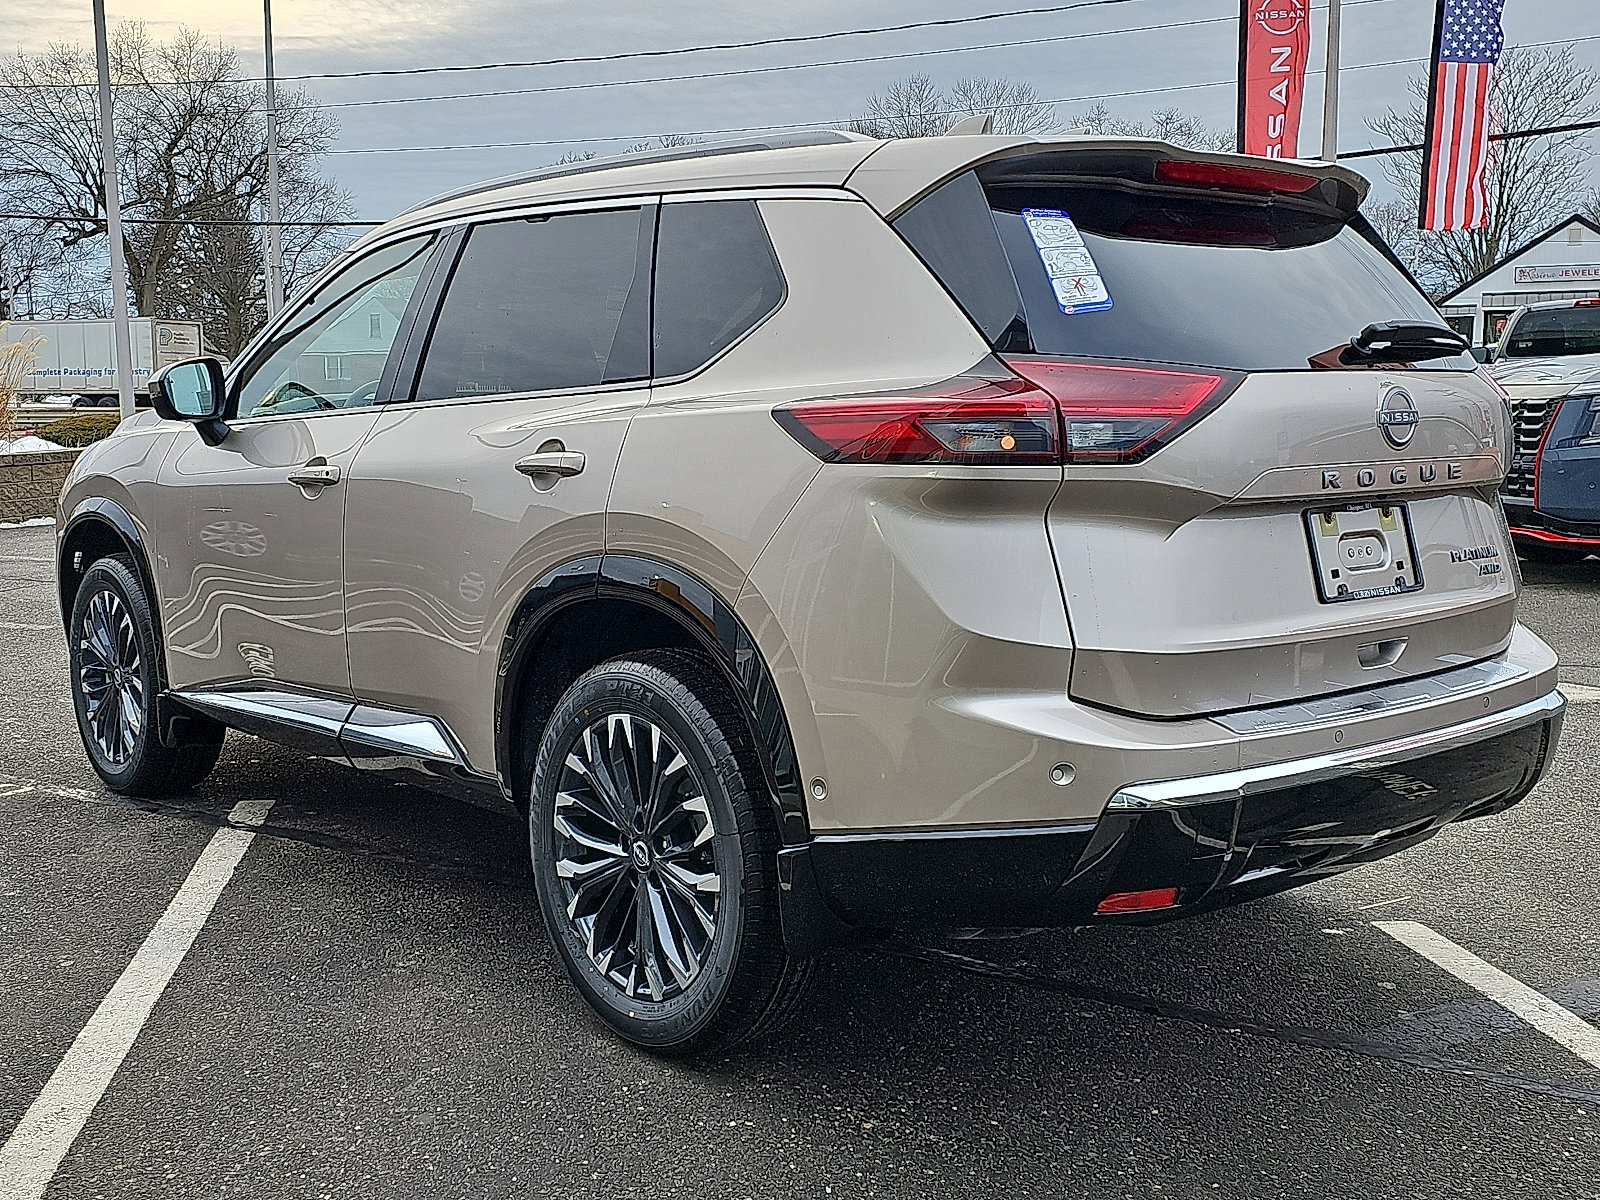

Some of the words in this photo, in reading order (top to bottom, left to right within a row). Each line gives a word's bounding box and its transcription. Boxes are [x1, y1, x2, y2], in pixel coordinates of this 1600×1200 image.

[1256, 10, 1305, 21] NISSAN
[1266, 46, 1292, 159] SSAN
[63, 367, 102, 377] Packaging
[104, 367, 116, 376] for
[1381, 412, 1419, 422] NISSAN
[1322, 463, 1462, 489] ROGUE
[1450, 545, 1499, 563] PLATINUM
[1479, 563, 1501, 576] AWD
